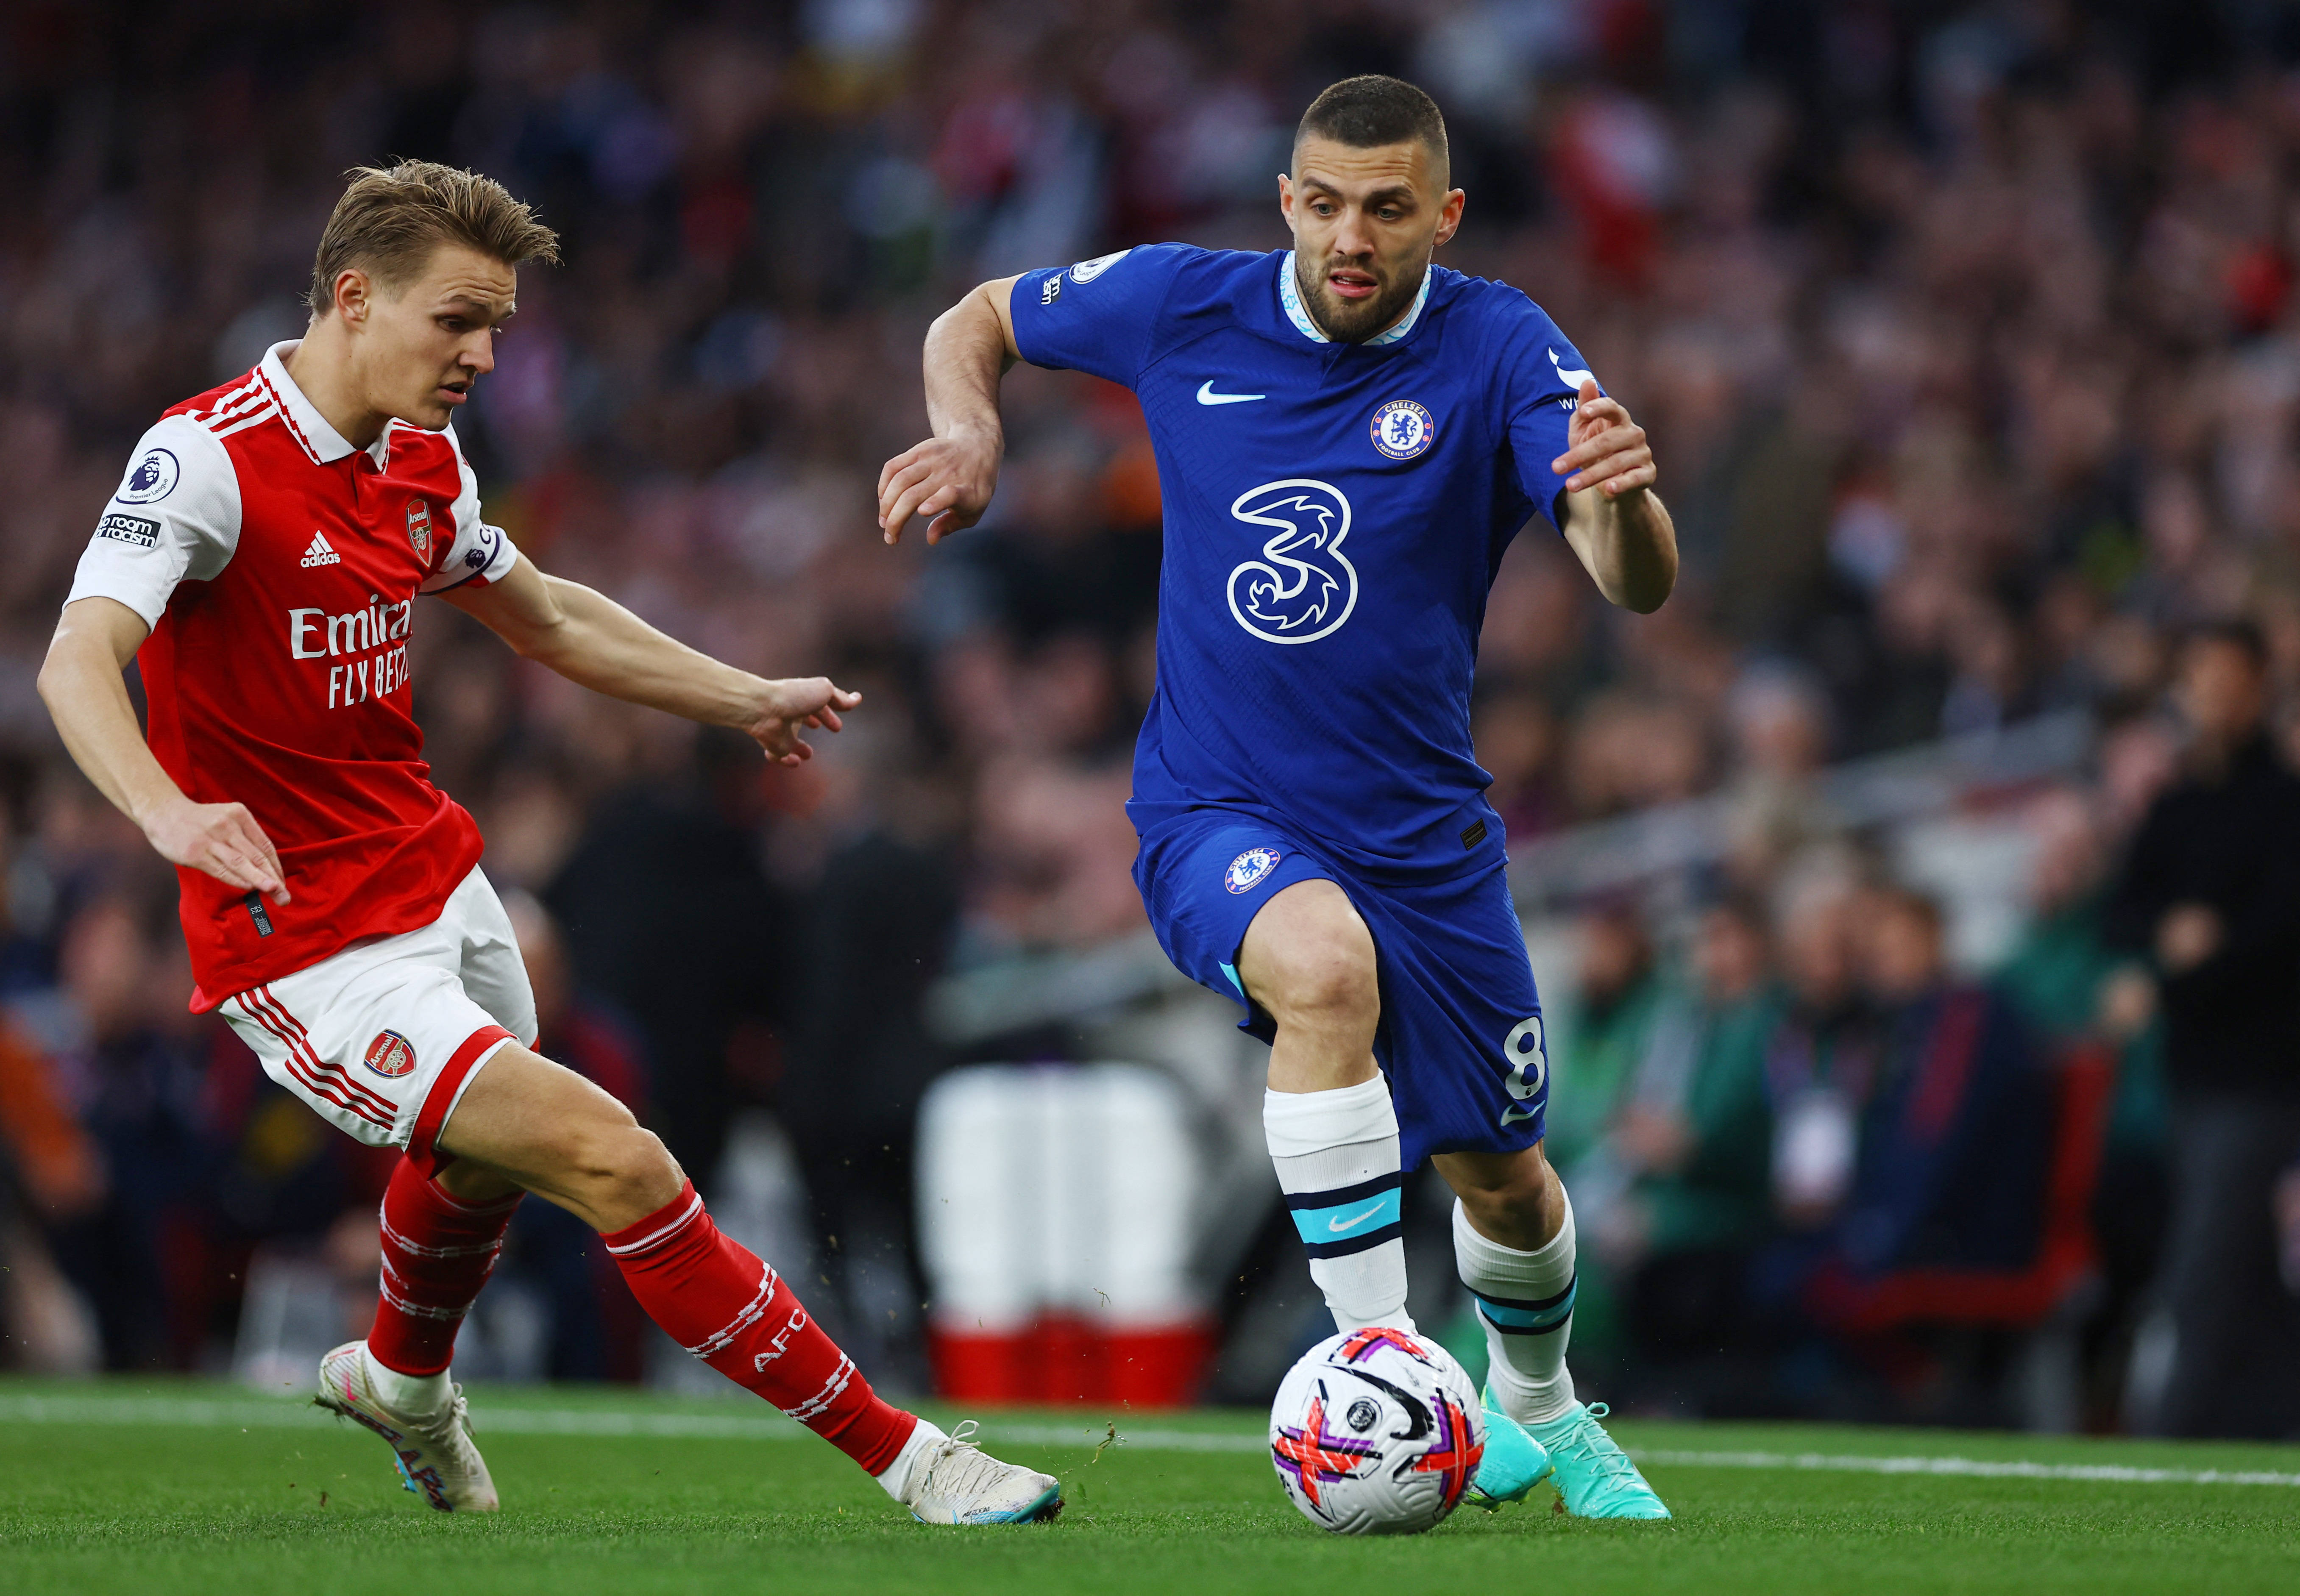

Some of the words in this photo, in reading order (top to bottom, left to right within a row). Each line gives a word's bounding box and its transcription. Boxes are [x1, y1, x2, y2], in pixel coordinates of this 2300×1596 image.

[1385, 402, 1426, 417] CHELSEA
[1378, 443, 1404, 457] FOOTBALL
[1406, 447, 1420, 456] CLUB
[151, 478, 168, 495] League
[111, 517, 152, 534] room
[409, 509, 426, 524] Arsenal
[106, 527, 156, 547] racism
[300, 552, 340, 568] adidas
[1227, 478, 1358, 645] 3
[288, 585, 413, 659] Emira
[329, 660, 368, 709] FLY
[375, 639, 410, 699] BETT
[1230, 848, 1264, 871] CHELSEA
[1239, 876, 1262, 891] FOOTBALL
[1262, 865, 1273, 876] CLUB
[370, 1035, 394, 1067] Arsenal
[1504, 1017, 1545, 1100] 8
[754, 1308, 807, 1372] AFC
